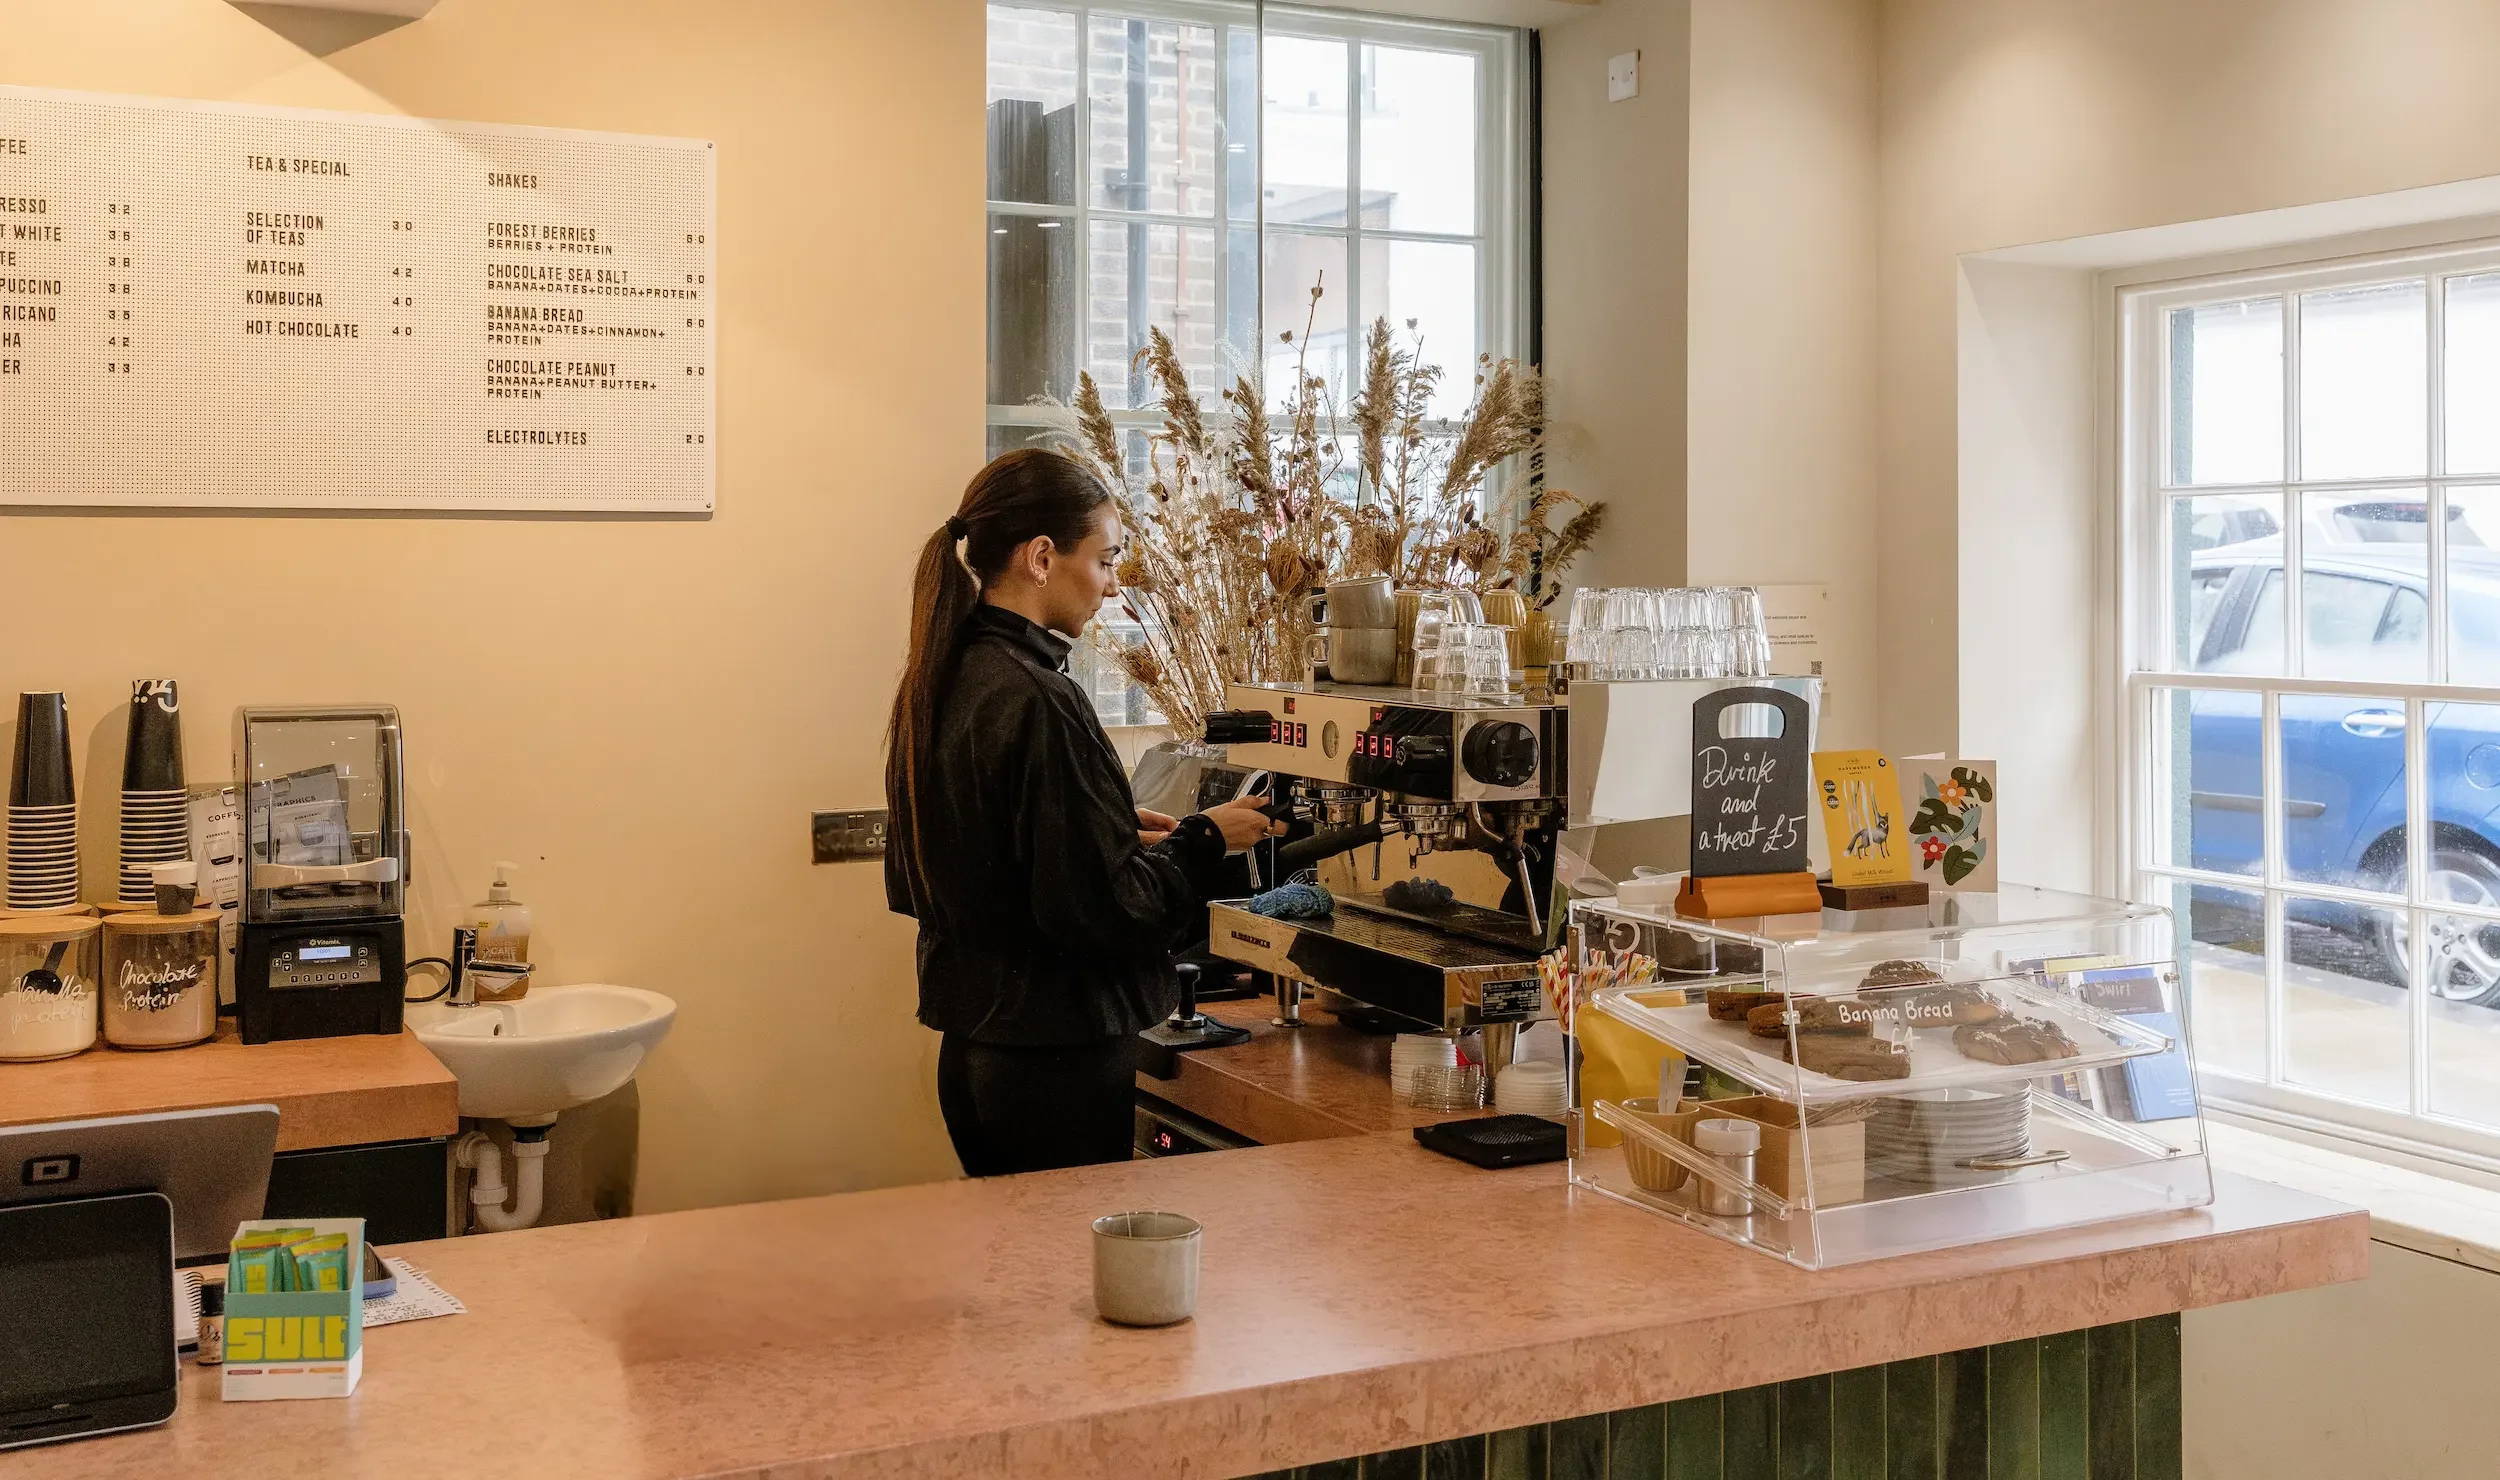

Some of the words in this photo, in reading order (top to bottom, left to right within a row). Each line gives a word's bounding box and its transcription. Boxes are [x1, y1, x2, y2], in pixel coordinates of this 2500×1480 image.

[247, 155, 273, 172] TEA
[279, 158, 287, 173] &
[293, 159, 351, 177] SPECIAL
[487, 172, 538, 190] SHAKES
[247, 212, 324, 231] SELECTION
[13, 224, 61, 242] WHITE
[247, 229, 263, 244] OF
[271, 231, 305, 246] TEAS
[488, 222, 537, 239] FOREST
[543, 225, 596, 242] BERRIES
[488, 238, 542, 251] BERRIES
[559, 243, 612, 255] PROTEIN
[247, 260, 305, 277] MATCHA
[488, 263, 562, 281] CHOCOLATE
[568, 268, 592, 282] SEA
[597, 269, 629, 285] SALT
[246, 290, 323, 307] KOMBUCHA
[487, 304, 537, 321] BANANA
[543, 308, 584, 323] BREAD
[246, 320, 272, 335] HOT
[278, 322, 359, 339] CHOCOLATE
[487, 334, 542, 346] PROTEIN
[487, 359, 562, 376] CHOCOLATE
[568, 362, 617, 377] PEANUT
[487, 375, 596, 390] BANANA+PEANUT
[487, 388, 542, 400] PROTEIN
[487, 430, 588, 446] ELECTROLYTES
[1698, 746, 1776, 789] Drink
[1721, 784, 1760, 814] and
[1699, 831, 1711, 850] a
[1713, 815, 1766, 852] treat
[1762, 814, 1807, 853] £5
[120, 959, 198, 989] Chocolate
[1839, 1004, 1899, 1023] Banana
[1905, 1000, 1953, 1020] Bread
